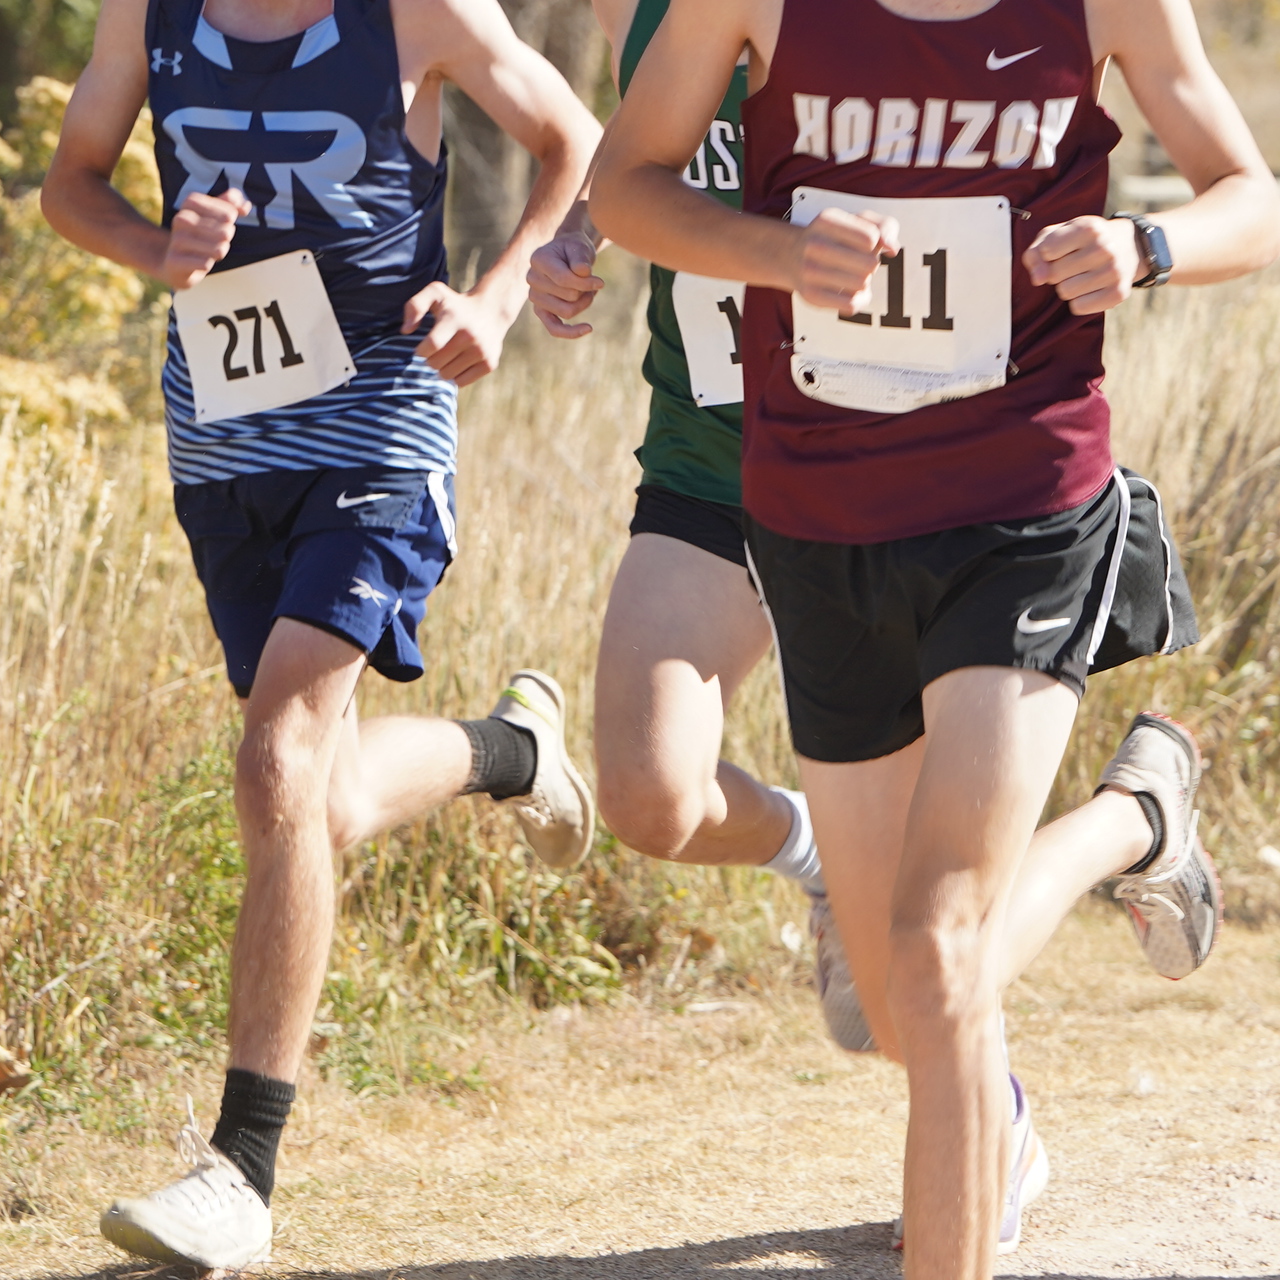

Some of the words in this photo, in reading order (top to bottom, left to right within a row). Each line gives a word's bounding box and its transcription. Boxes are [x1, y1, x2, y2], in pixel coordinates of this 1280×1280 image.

[792, 92, 1078, 169] HORIZON
[837, 247, 954, 331] 11
[207, 299, 305, 381] 271
